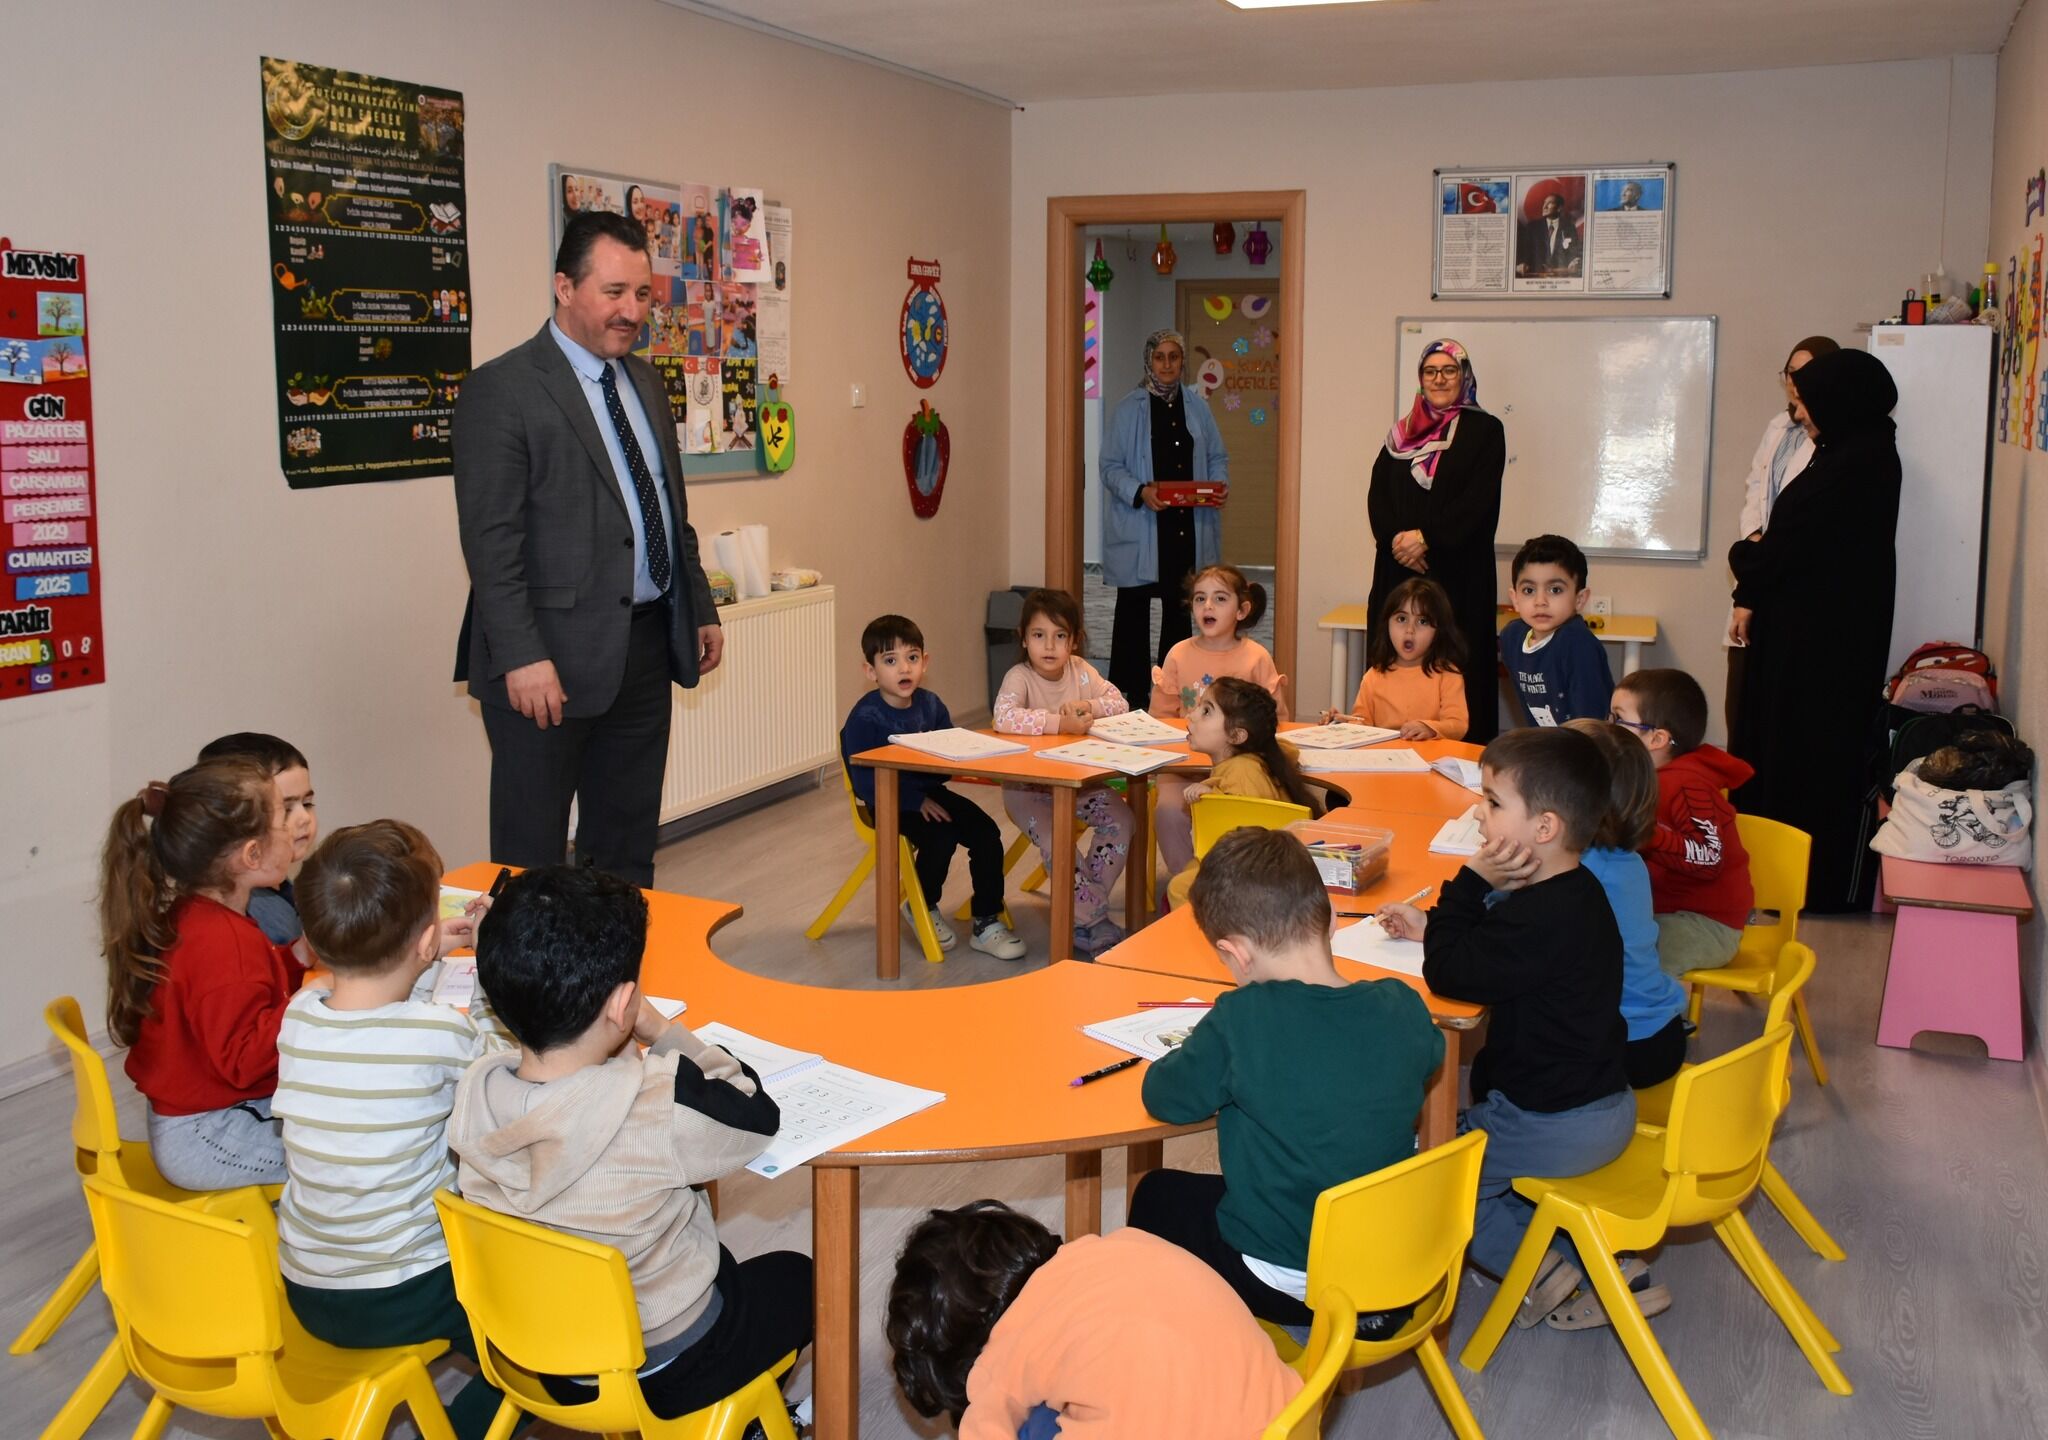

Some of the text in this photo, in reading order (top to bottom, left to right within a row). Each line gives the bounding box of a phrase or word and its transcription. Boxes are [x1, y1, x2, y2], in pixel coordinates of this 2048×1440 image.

[6, 252, 77, 278] MEVSİM
[28, 396, 64, 418] GÜN
[28, 450, 60, 464] SALI
[10, 475, 85, 492] ÇARŞAMBA
[12, 498, 85, 517] PERŞEMBE
[32, 524, 68, 542] 2029
[34, 576, 71, 596] 2025
[1944, 854, 2000, 863] TORONTO
